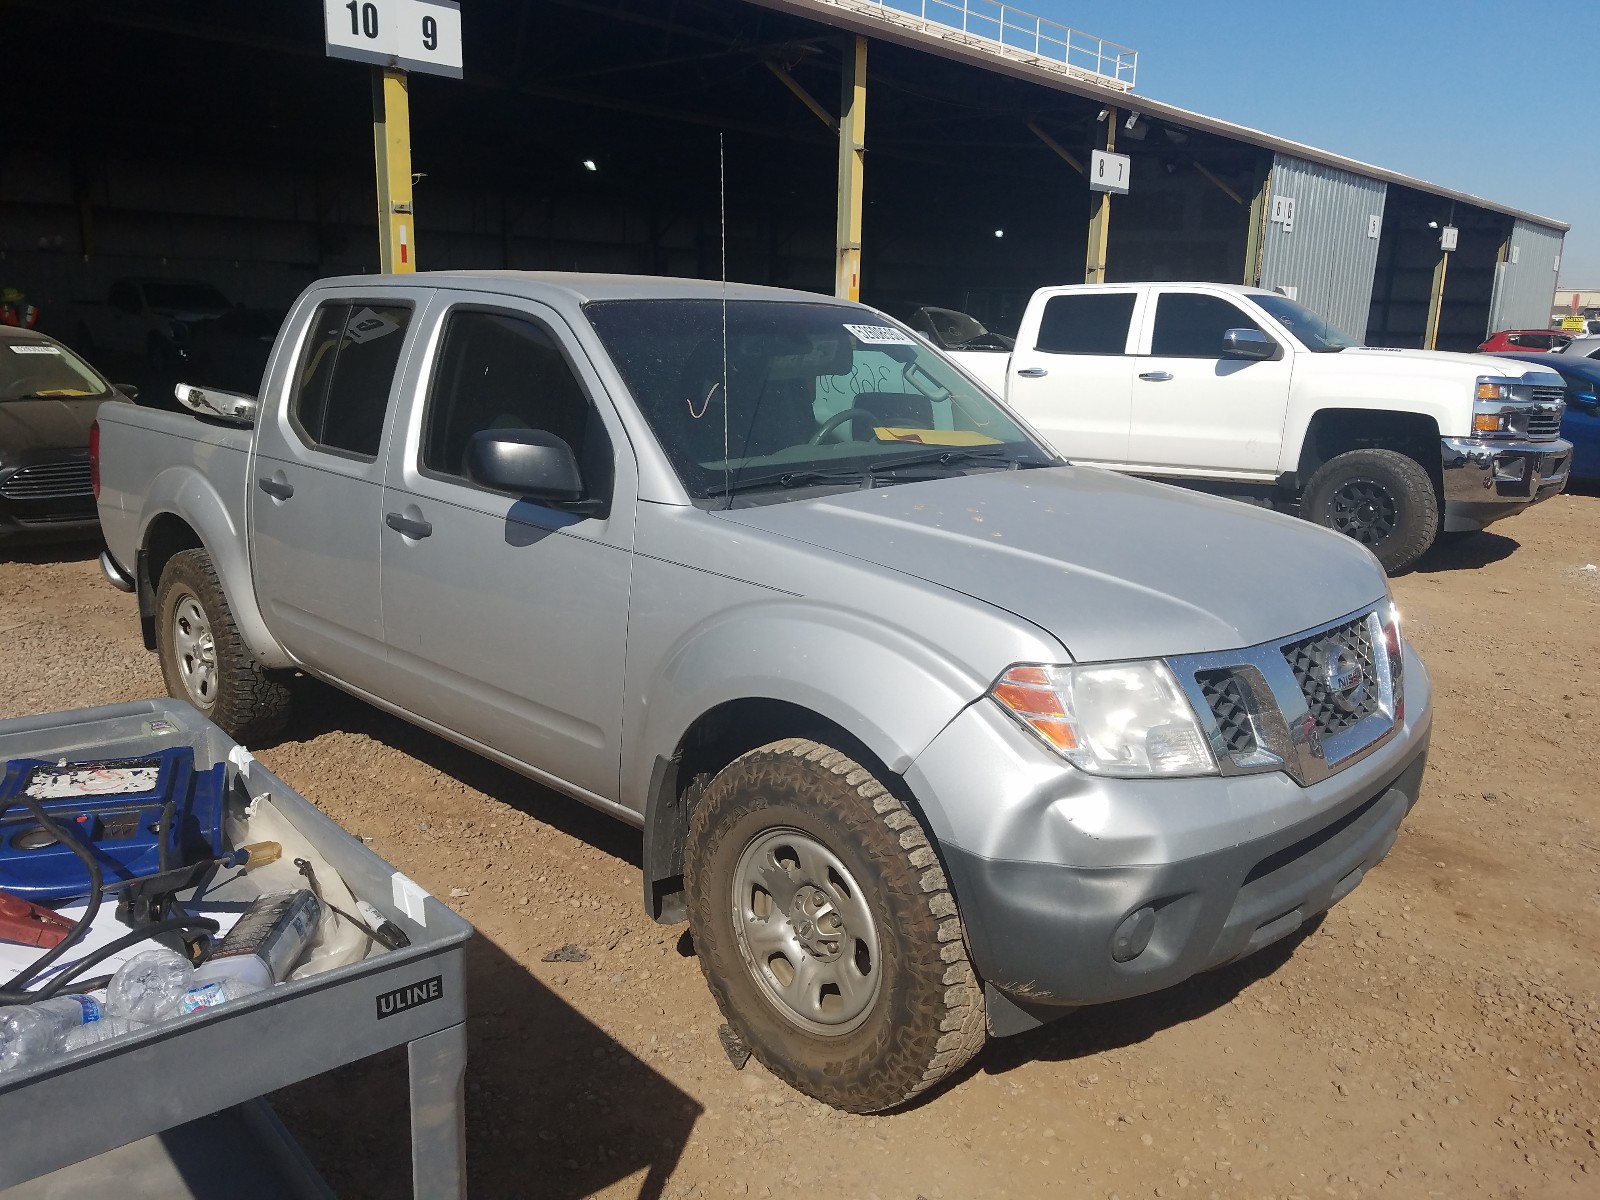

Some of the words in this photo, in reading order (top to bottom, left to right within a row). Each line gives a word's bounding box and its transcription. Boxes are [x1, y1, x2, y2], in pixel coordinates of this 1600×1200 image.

[346, 0, 379, 39] 10
[422, 15, 438, 51] 9
[1099, 158, 1105, 178] 8
[1118, 162, 1123, 182] 7
[380, 980, 439, 1013] ULINE
